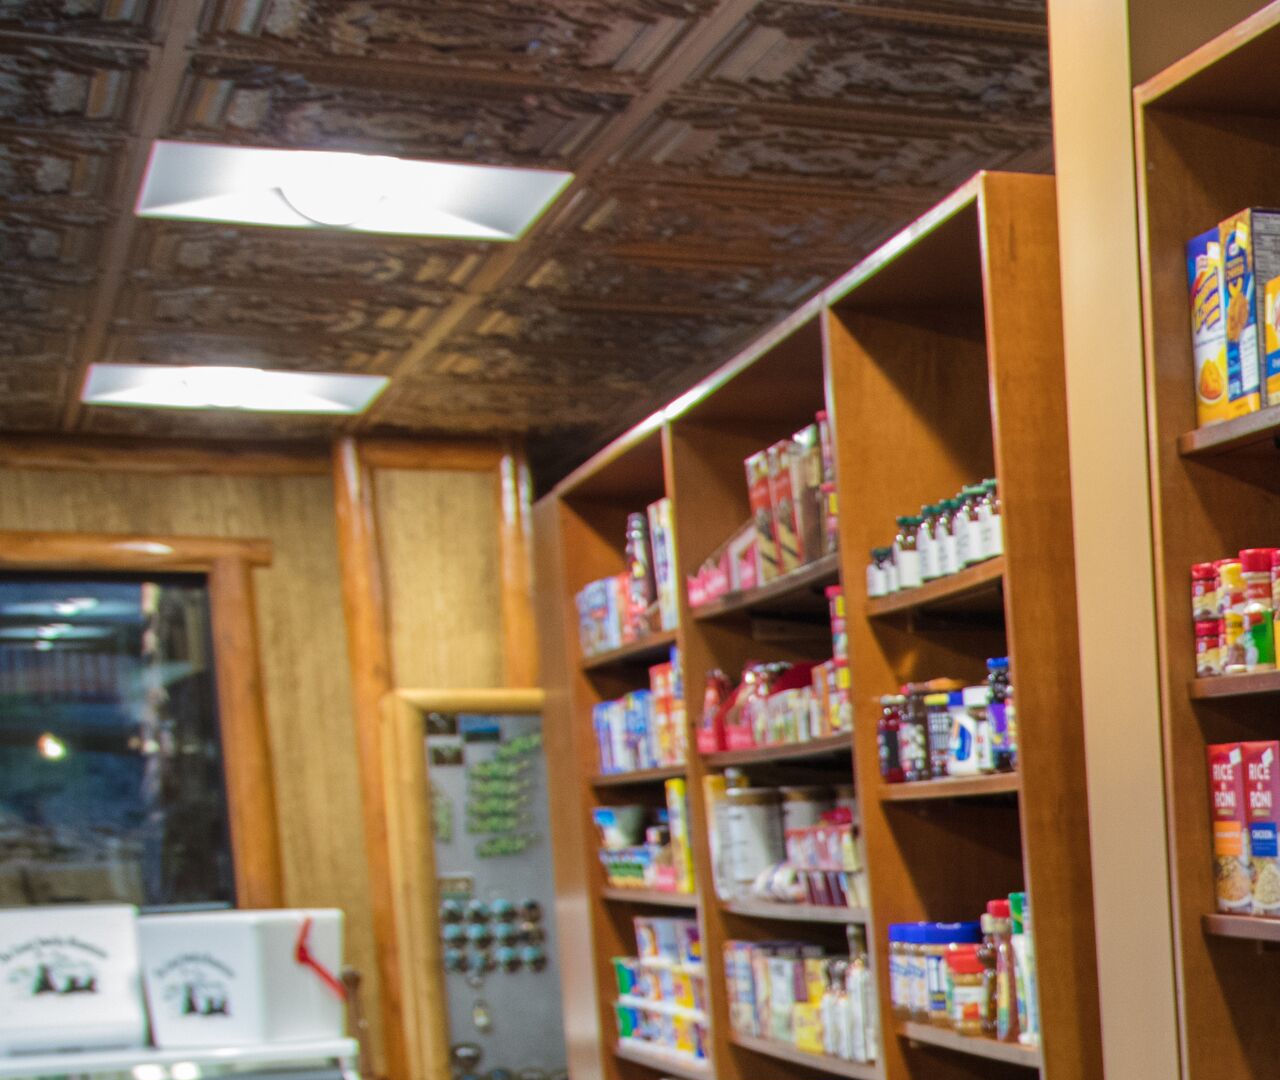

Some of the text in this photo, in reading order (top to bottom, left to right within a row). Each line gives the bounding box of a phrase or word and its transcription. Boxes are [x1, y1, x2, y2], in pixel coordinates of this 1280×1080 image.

[1212, 763, 1234, 780] RICE
[1248, 763, 1271, 781] RICE
[1213, 790, 1235, 808] RONI
[1249, 790, 1272, 808] RONI
